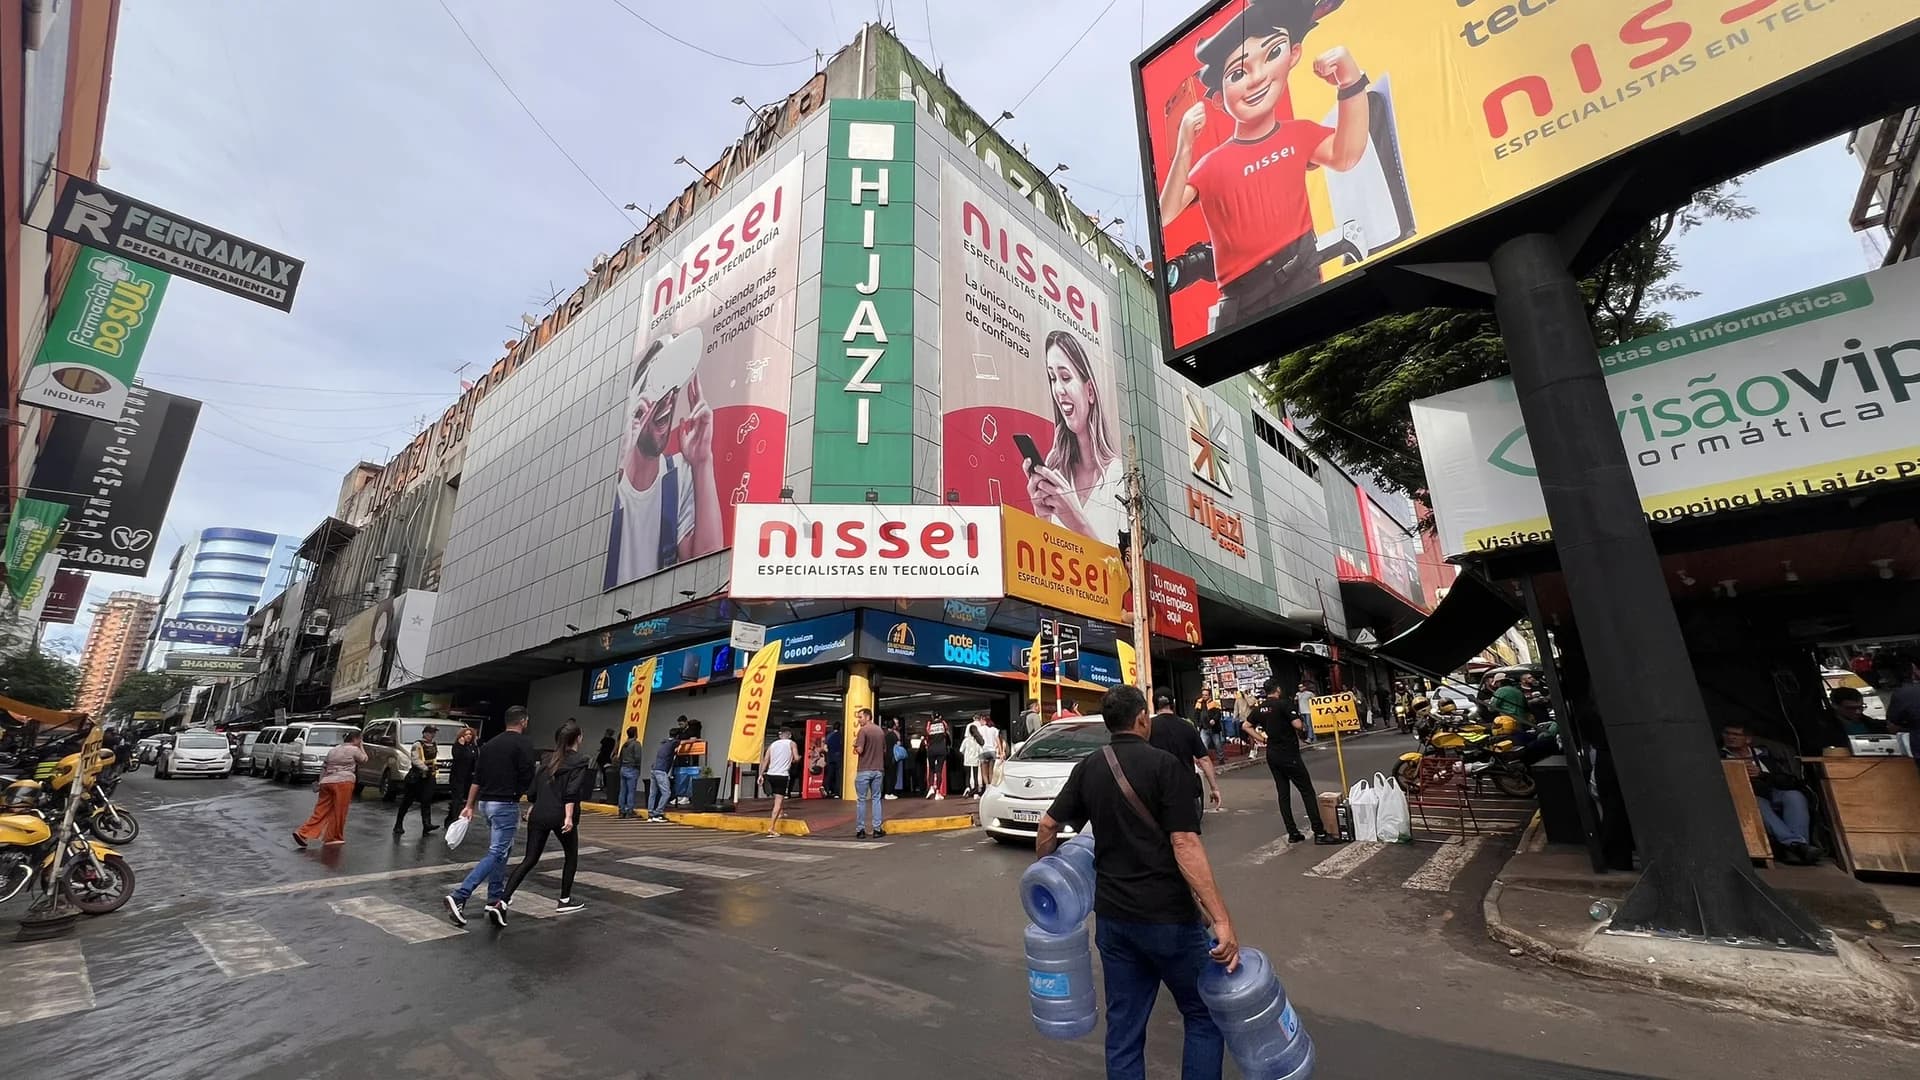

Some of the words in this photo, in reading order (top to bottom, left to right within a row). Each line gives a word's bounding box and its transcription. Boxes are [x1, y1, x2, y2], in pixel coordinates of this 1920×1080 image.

[1459, 0, 1557, 47] tec
[1495, 54, 1696, 160] ESPECIALISTAS
[1705, 28, 1750, 59] EN
[1243, 145, 1296, 177] nissei
[122, 207, 294, 285] FERRAMAX
[123, 239, 167, 261] PESCA
[171, 256, 180, 265] &
[185, 261, 281, 299] HERRAMIENTAS
[653, 185, 783, 315] nissei
[963, 200, 1099, 333] nissei
[651, 282, 707, 330] ESPECIALISTAS
[708, 270, 720, 287] EN
[722, 226, 780, 277] TECNOLOGÍA
[713, 303, 723, 318] La
[725, 283, 755, 309] tienda
[756, 266, 777, 287] más
[963, 239, 1036, 299] ESPECIALISTAS
[1038, 294, 1050, 311] EN
[1051, 305, 1101, 346] TECNOLOGÍA
[965, 273, 978, 291] La
[980, 284, 1007, 309] única
[1008, 304, 1025, 323] con
[93, 280, 151, 355] DOSUL
[706, 340, 718, 354] en
[720, 302, 775, 346] TripAdvisor
[712, 284, 776, 334] recomendada
[842, 166, 889, 444] HIJAZI
[965, 292, 992, 318] nivel
[991, 308, 1031, 343] japonés
[1598, 345, 1652, 368] istas
[1655, 336, 1686, 353] en
[1689, 291, 1847, 343] informática
[965, 310, 980, 327] de
[981, 322, 1030, 358] confianza
[43, 388, 106, 409] INDUFAR
[1638, 402, 1884, 466] ormática
[1755, 482, 1797, 502] Lai
[1803, 472, 1848, 494] Lai
[1185, 484, 1245, 545] Hijazi
[758, 520, 979, 559] nissei
[1050, 538, 1078, 553] LLEGASTE
[1078, 547, 1084, 555] A
[1477, 529, 1553, 551] Visíten
[758, 565, 865, 576] ESPECIALISTAS
[869, 565, 888, 575] EN
[892, 562, 979, 576] TECNOLOGÍA
[1017, 540, 1109, 595] nissei
[1018, 572, 1065, 592] ESPECIALISTAS
[1066, 586, 1075, 596] EN
[1153, 574, 1163, 588] Tu
[1164, 580, 1187, 597] mundo
[164, 620, 238, 634] ATACADO
[1166, 595, 1194, 613] empieza
[180, 660, 244, 669] SHAMSONIC
[944, 639, 990, 667] books
[948, 634, 973, 648] note
[630, 675, 646, 722] ssei
[743, 664, 769, 736] nissei
[1311, 694, 1351, 706] MOTO
[1316, 705, 1349, 715] TAXI
